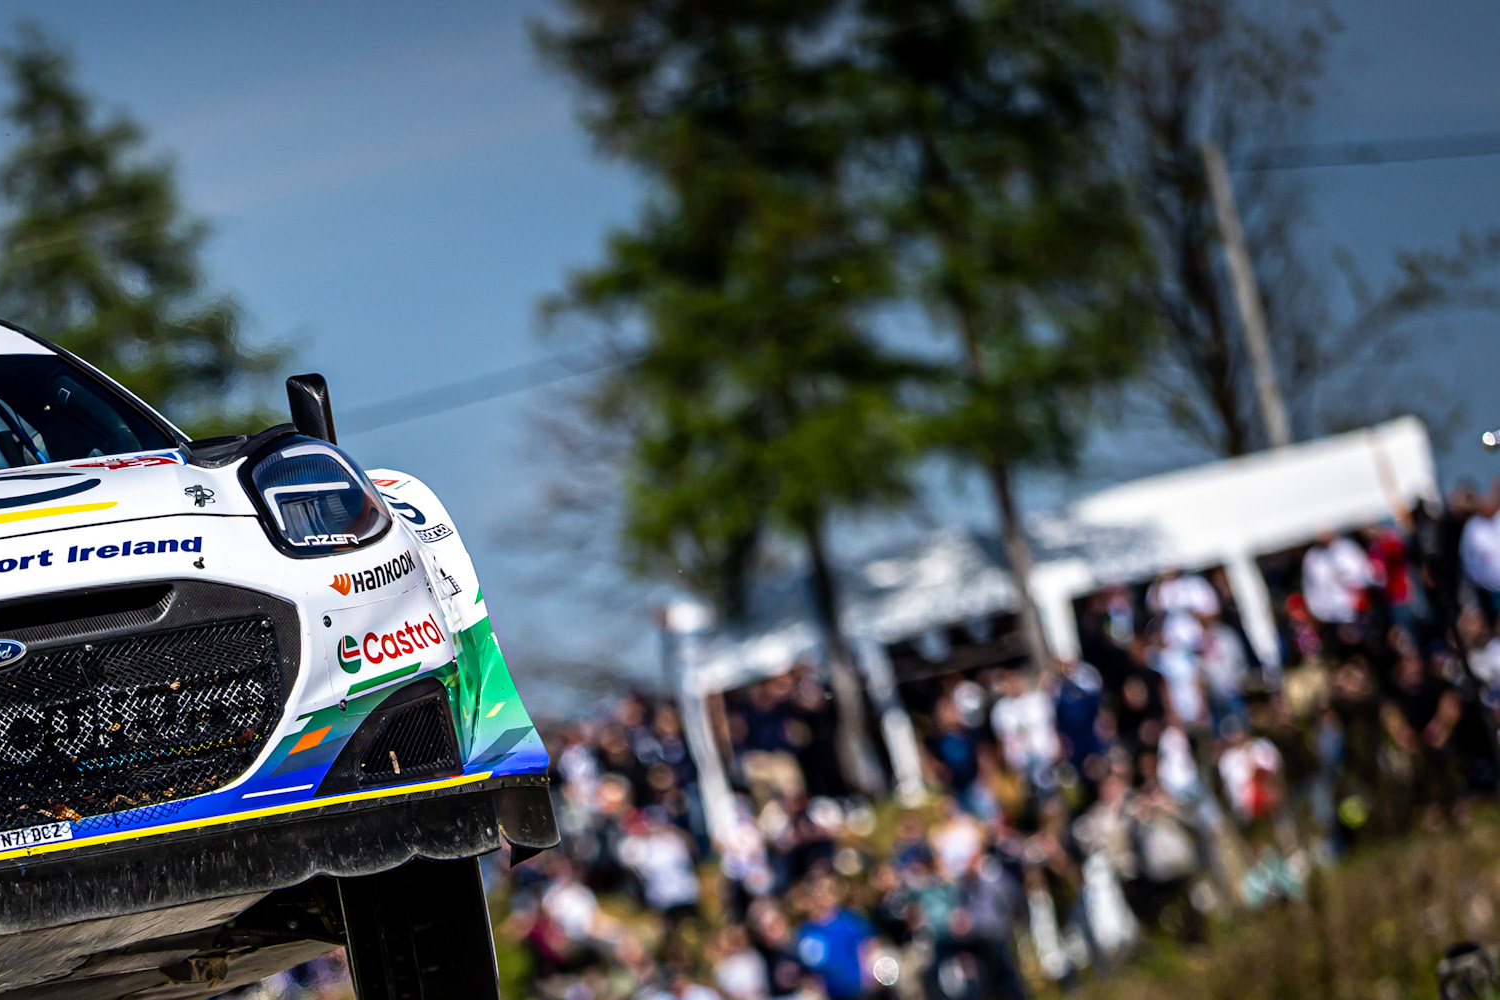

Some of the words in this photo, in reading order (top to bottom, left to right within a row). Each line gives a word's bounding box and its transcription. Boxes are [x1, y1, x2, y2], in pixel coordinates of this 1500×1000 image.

[67, 536, 203, 565] Ireland
[362, 613, 446, 664] Castrol
[31, 824, 62, 842] DCZ
